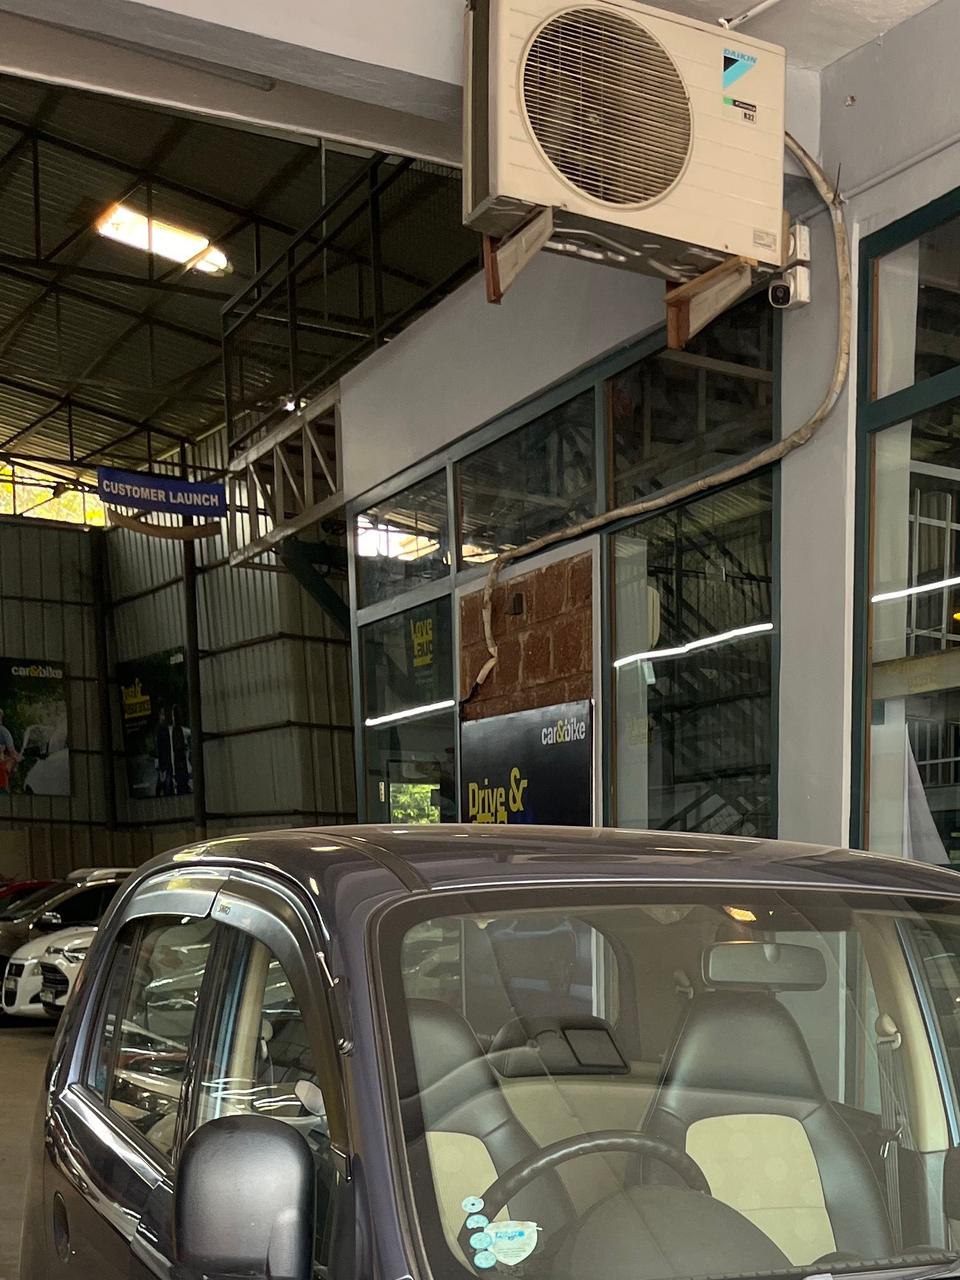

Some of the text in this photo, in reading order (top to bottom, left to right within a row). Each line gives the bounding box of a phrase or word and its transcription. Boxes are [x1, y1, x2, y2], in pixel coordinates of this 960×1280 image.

[723, 48, 757, 64] DAIKIN
[103, 480, 219, 507] CUSTOMER LAUNCH
[11, 665, 63, 679] car&bike
[541, 717, 586, 745] car&bike
[468, 767, 528, 817] Drive &
